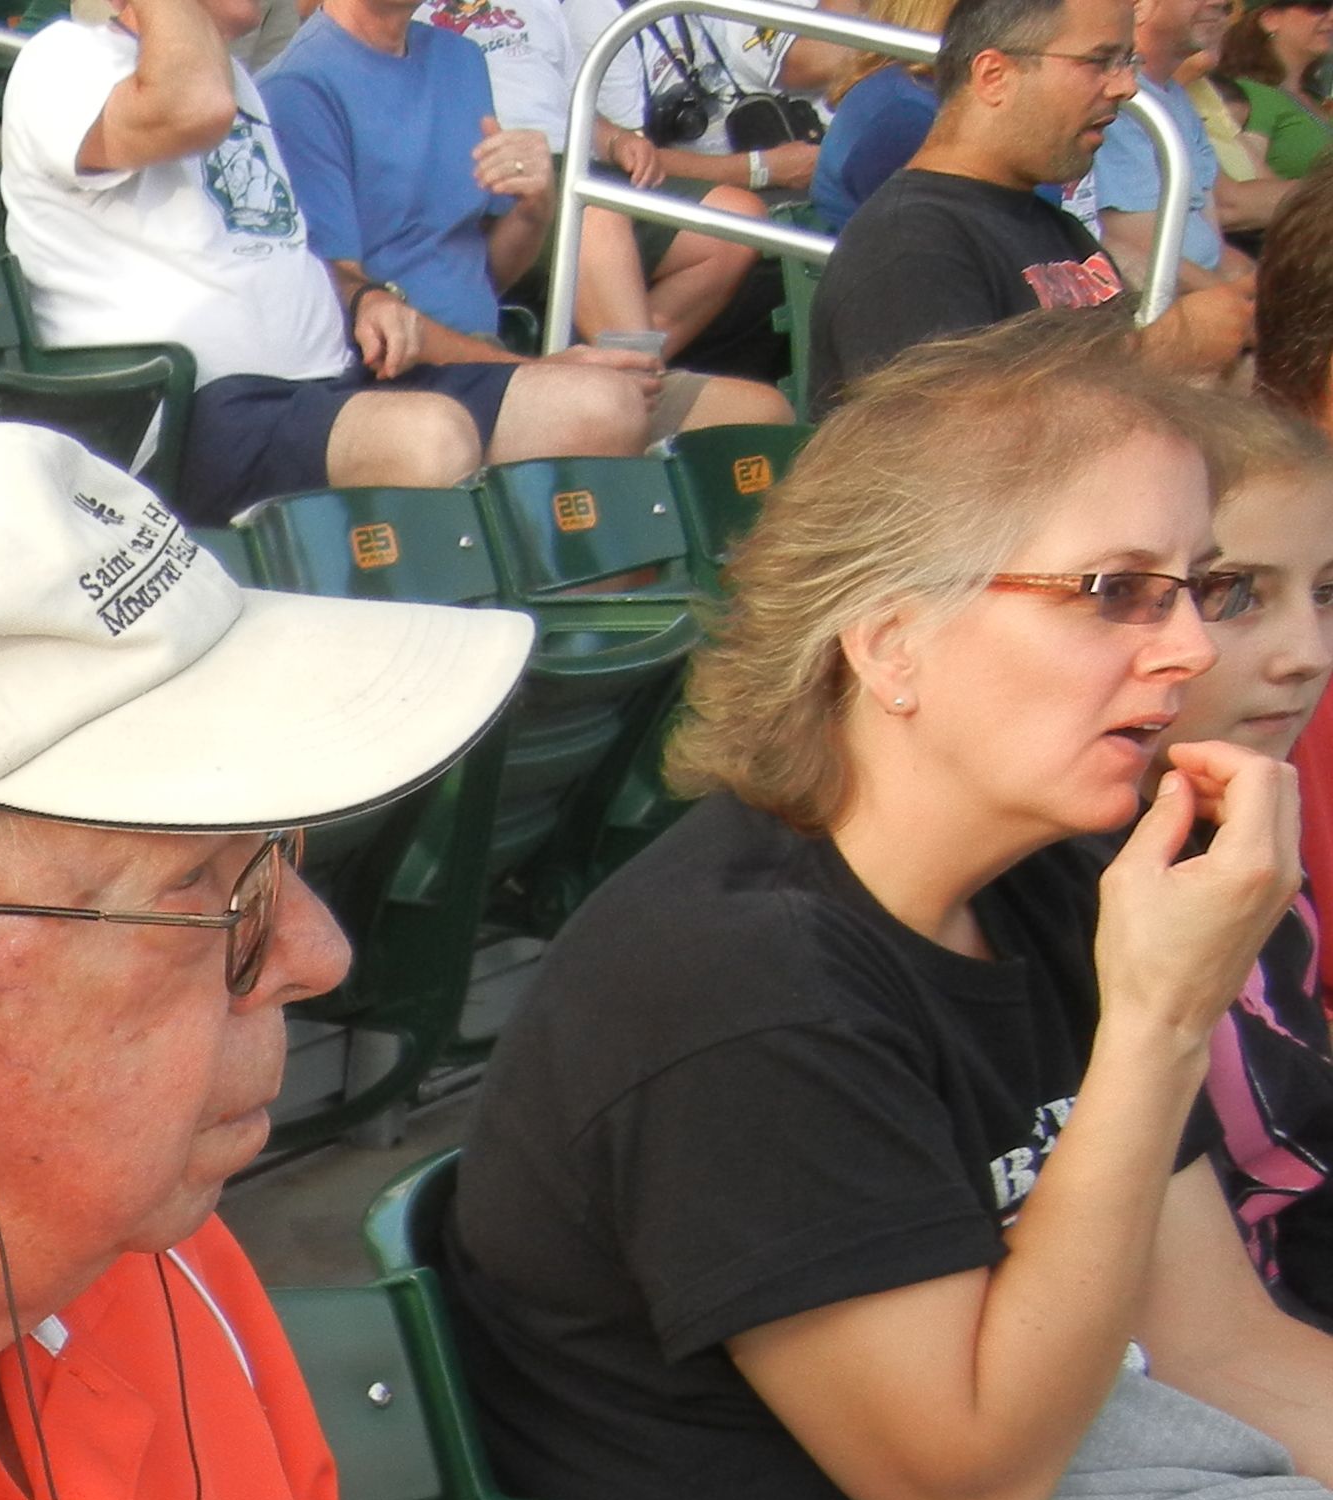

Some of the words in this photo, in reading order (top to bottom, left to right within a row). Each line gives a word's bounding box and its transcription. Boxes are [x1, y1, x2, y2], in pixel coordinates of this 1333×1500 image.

[737, 458, 764, 481] 27
[557, 494, 591, 518] 26
[355, 527, 390, 553] 25
[79, 546, 136, 602] Saint
